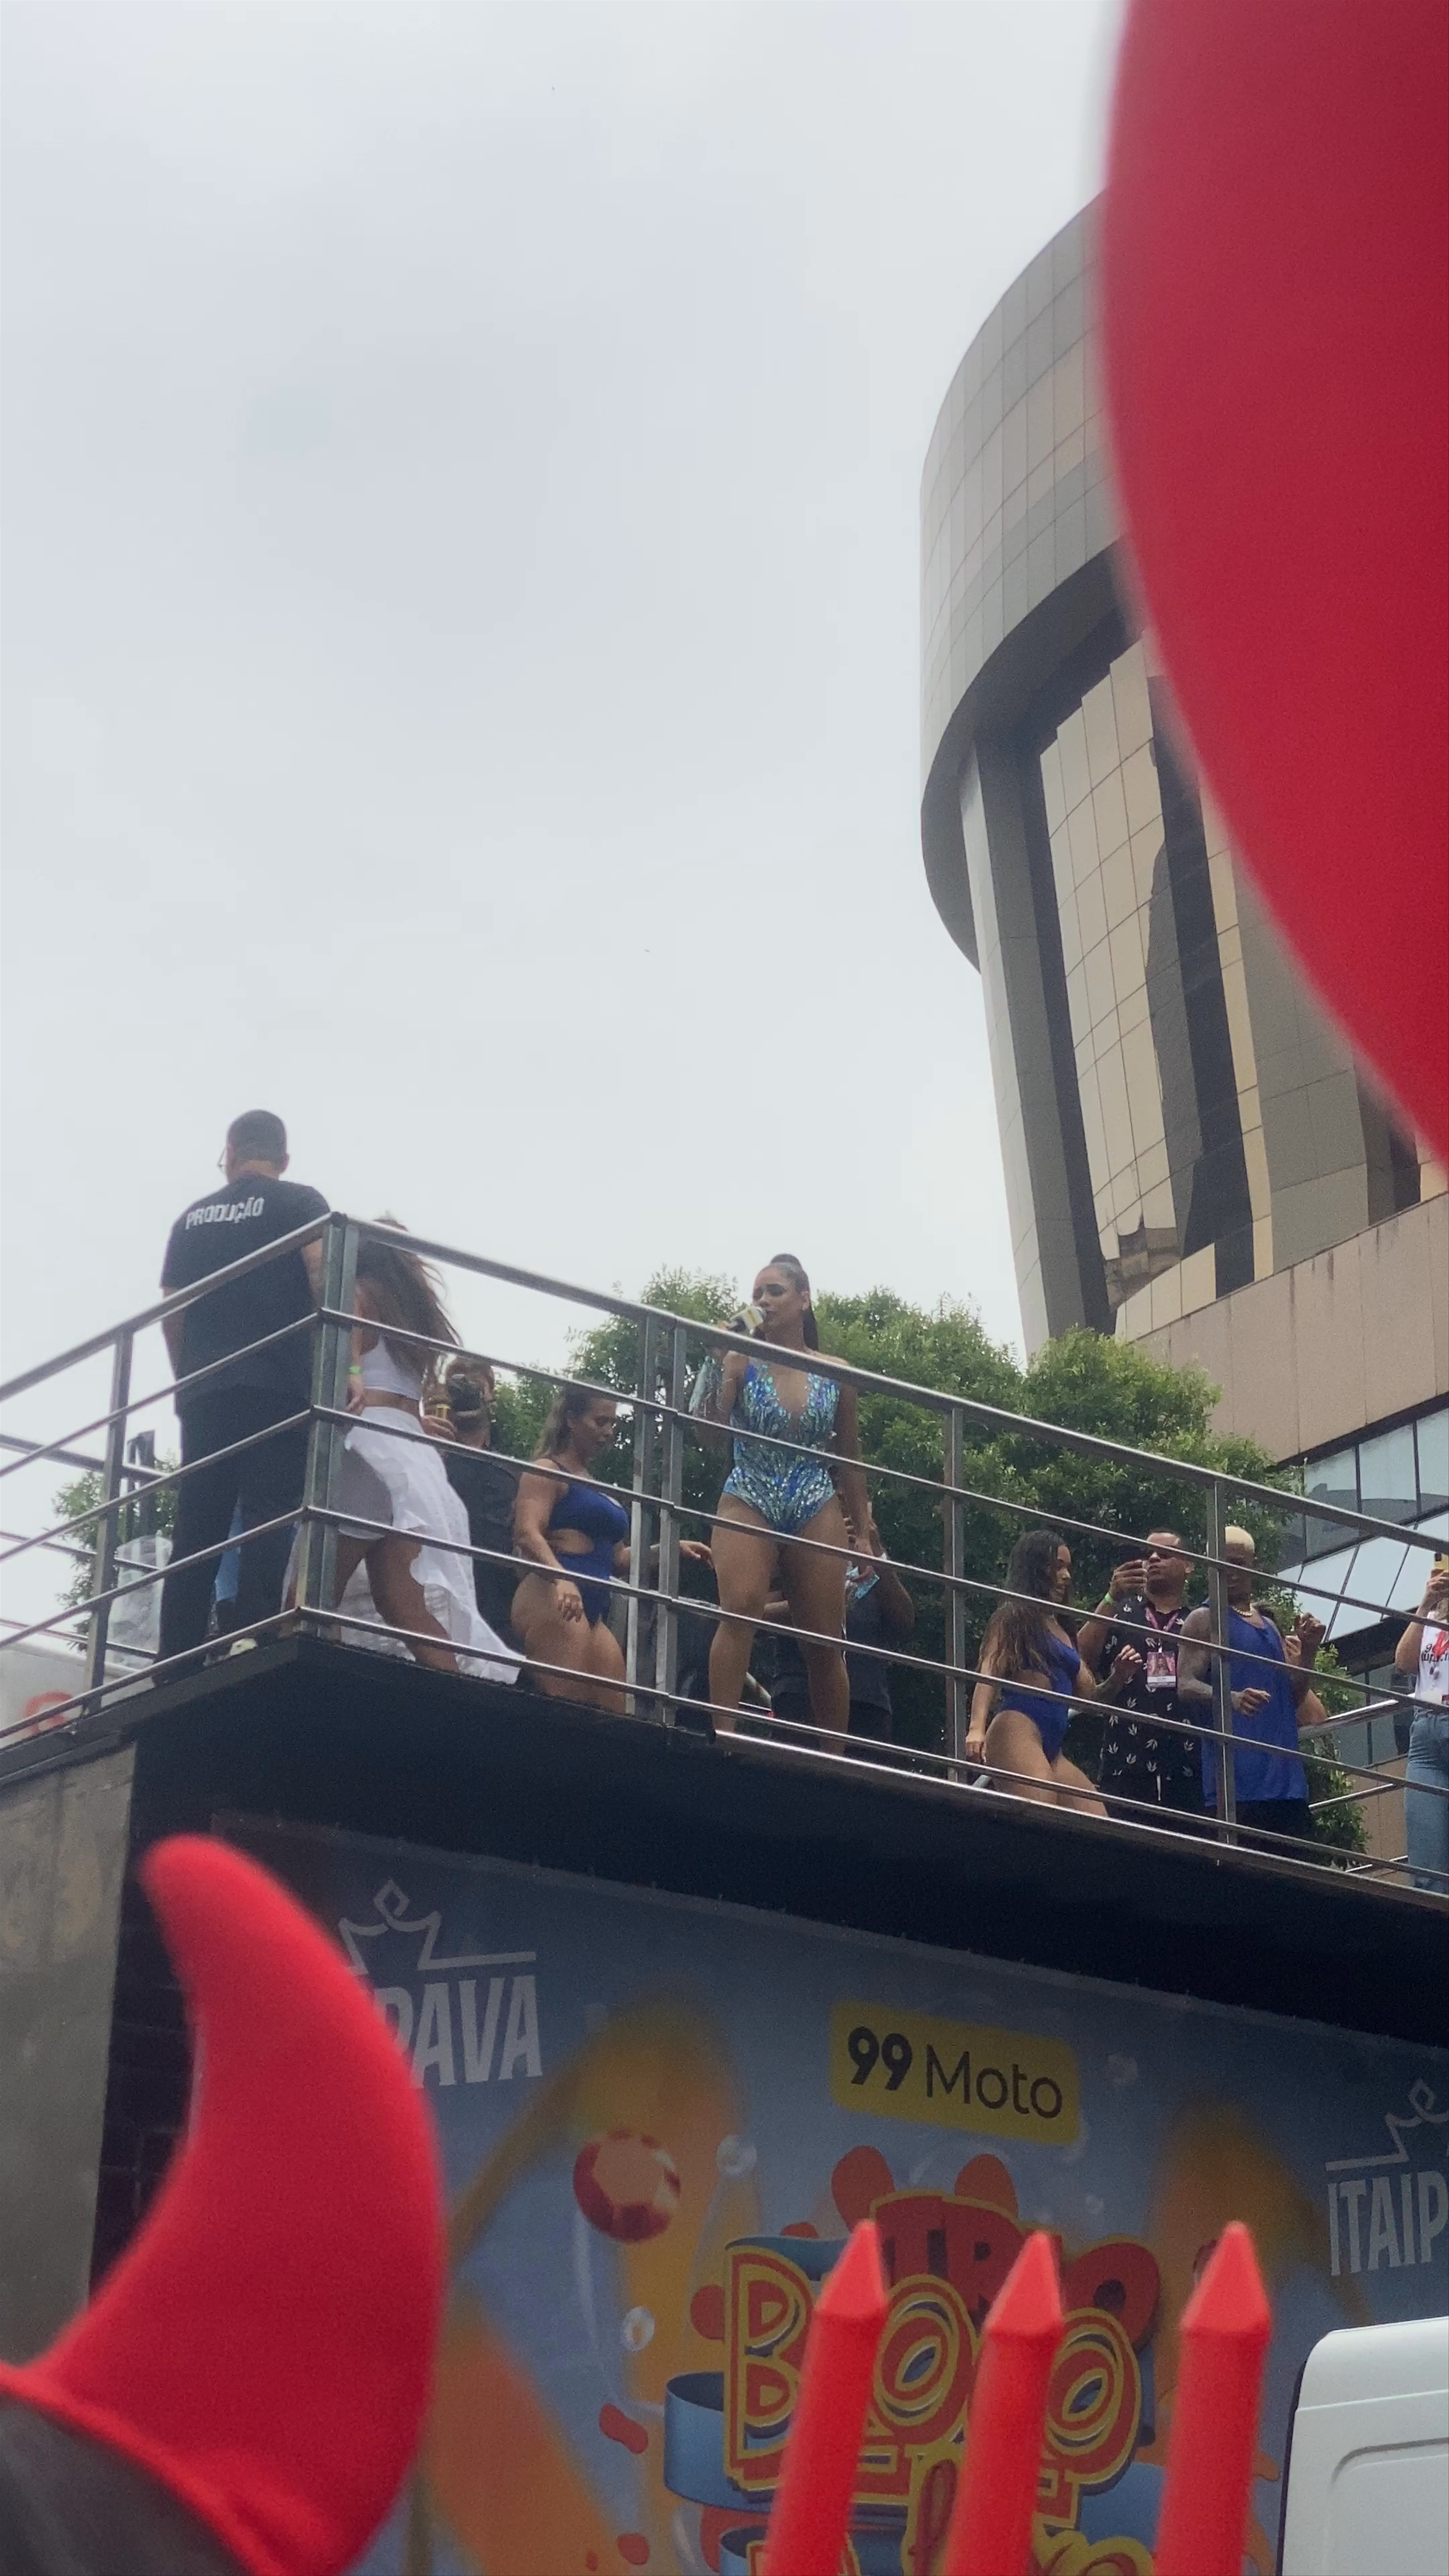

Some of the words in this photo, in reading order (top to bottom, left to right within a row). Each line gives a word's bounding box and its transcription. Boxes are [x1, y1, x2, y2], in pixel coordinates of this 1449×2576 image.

[185, 1195, 265, 1230] PRODUÇÃO
[848, 2026, 913, 2091] 99
[926, 2044, 1063, 2119] Moto
[1327, 2170, 1449, 2276] ITAIP
